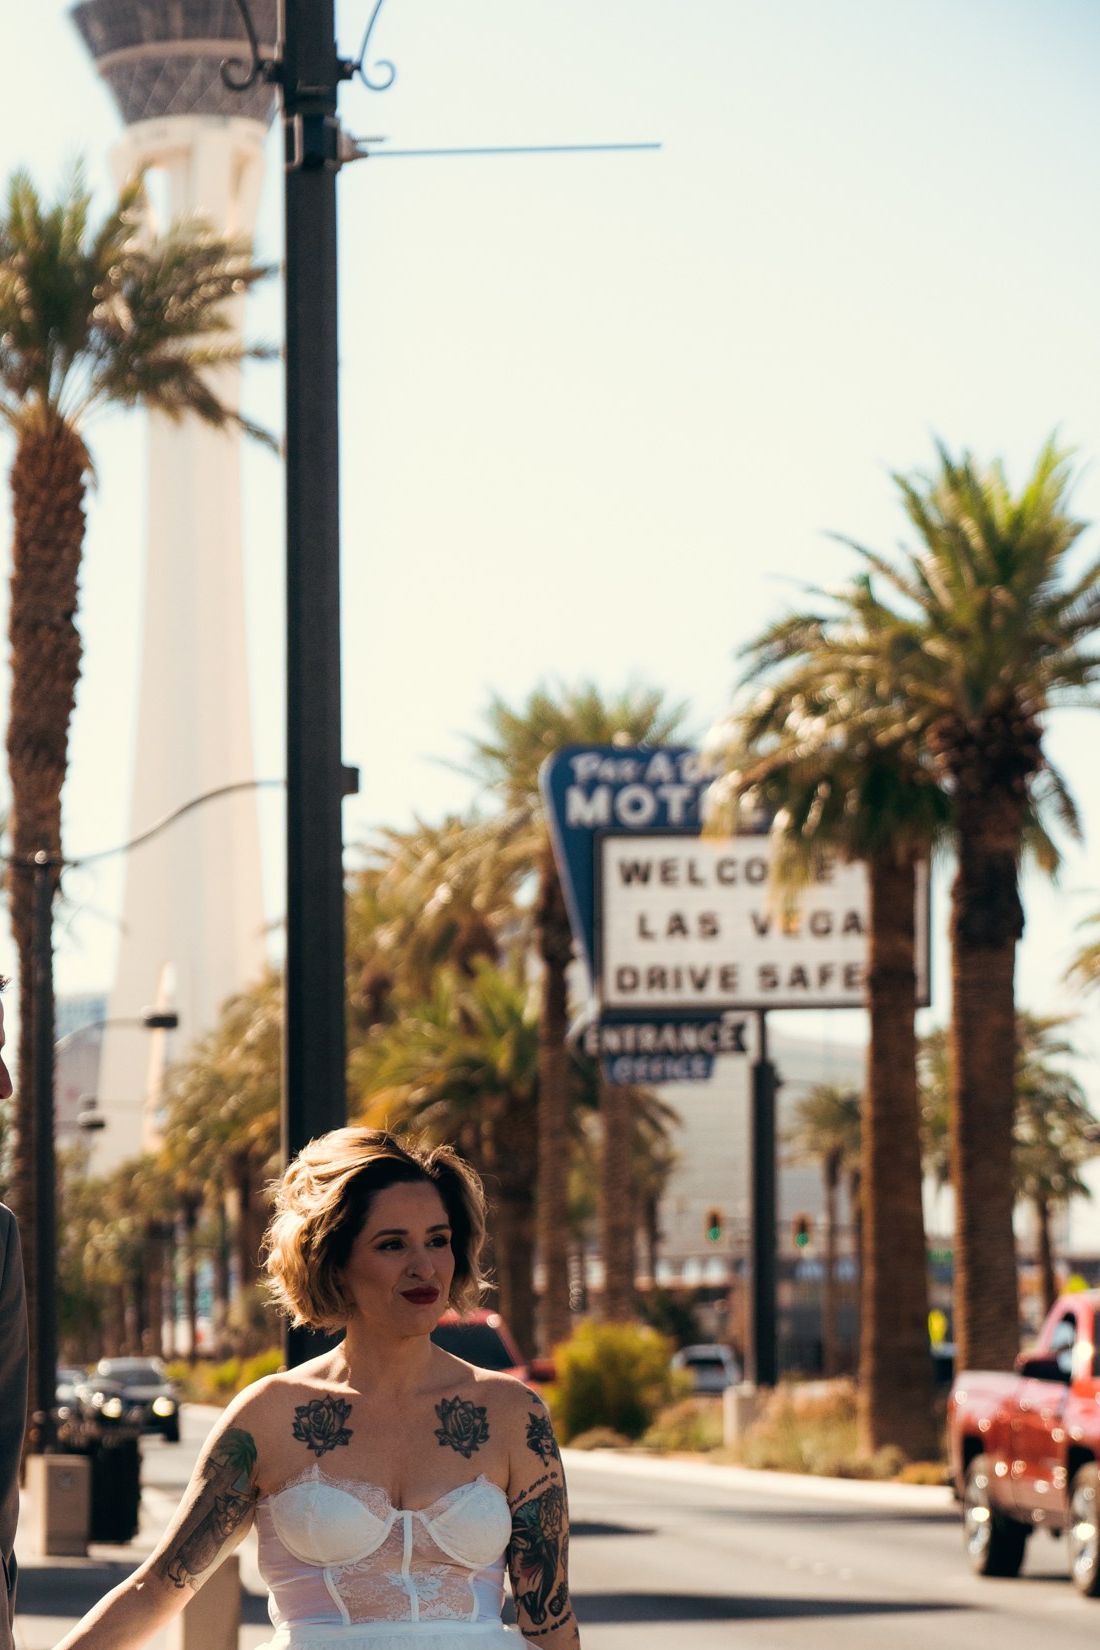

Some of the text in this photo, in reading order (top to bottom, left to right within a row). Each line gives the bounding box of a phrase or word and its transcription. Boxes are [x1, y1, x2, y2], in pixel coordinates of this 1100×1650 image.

[565, 784, 770, 827] MOT
[618, 857, 836, 886] WELCOE
[637, 911, 865, 940] LAS VEGA
[614, 962, 865, 995] DRIVE SAFE
[584, 1022, 740, 1056] ENTRANCE
